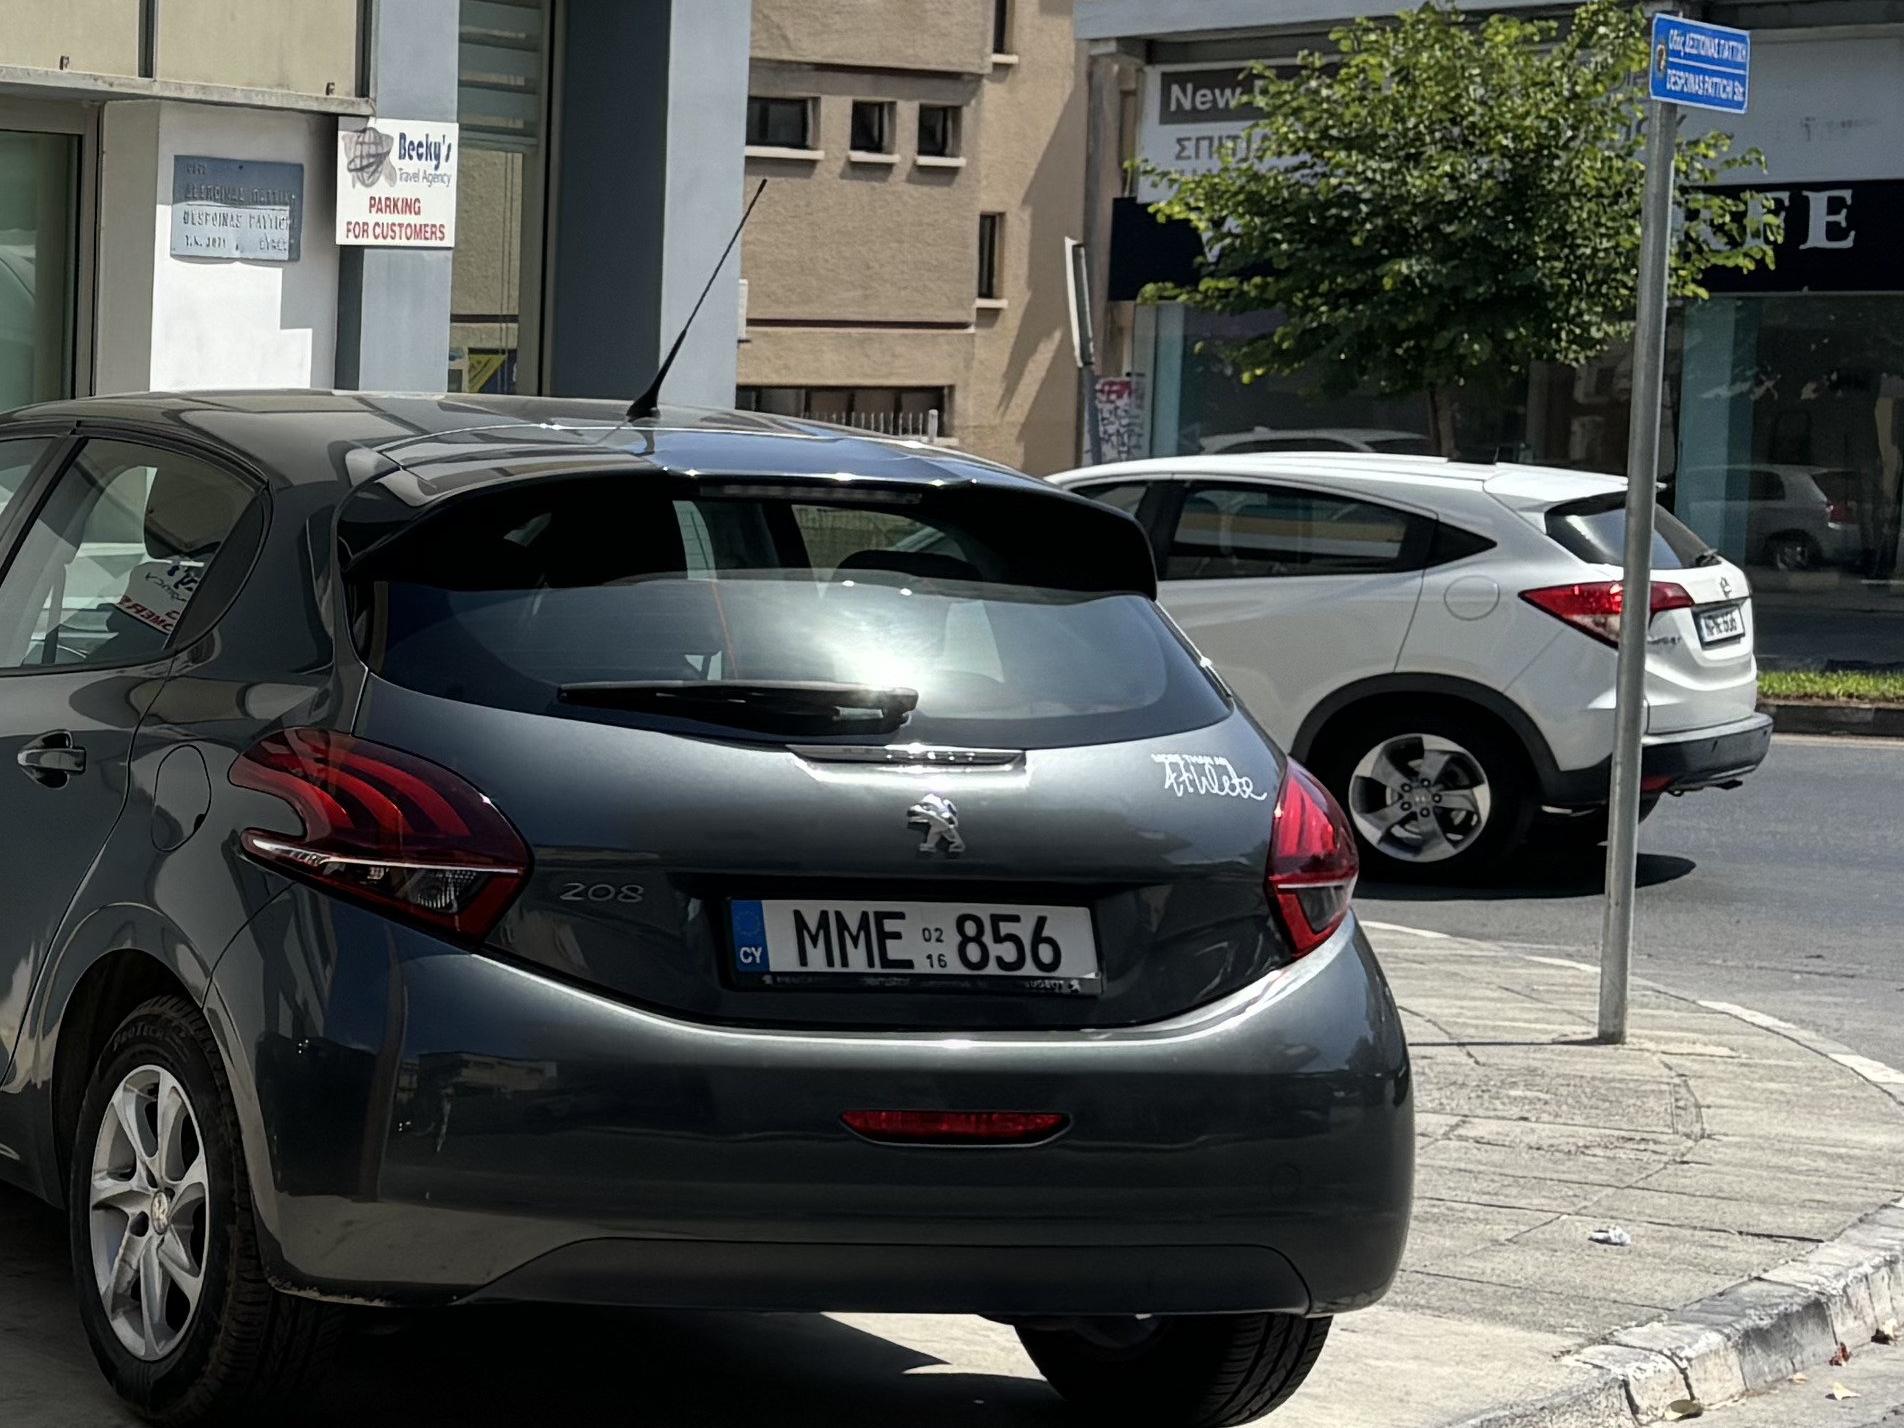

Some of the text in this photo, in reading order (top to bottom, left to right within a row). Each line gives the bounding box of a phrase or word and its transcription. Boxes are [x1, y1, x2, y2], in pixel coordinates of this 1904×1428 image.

[1169, 81, 1243, 112] New
[398, 132, 452, 172] Becky's
[398, 168, 452, 188] Travel Agency
[369, 196, 421, 216] PARKING
[346, 221, 446, 241] FOR CUSTOMERS
[559, 882, 645, 904] 208
[793, 909, 1062, 973] MME 856
[922, 927, 944, 943] 02
[739, 946, 763, 965] CY
[926, 953, 948, 969] 16
